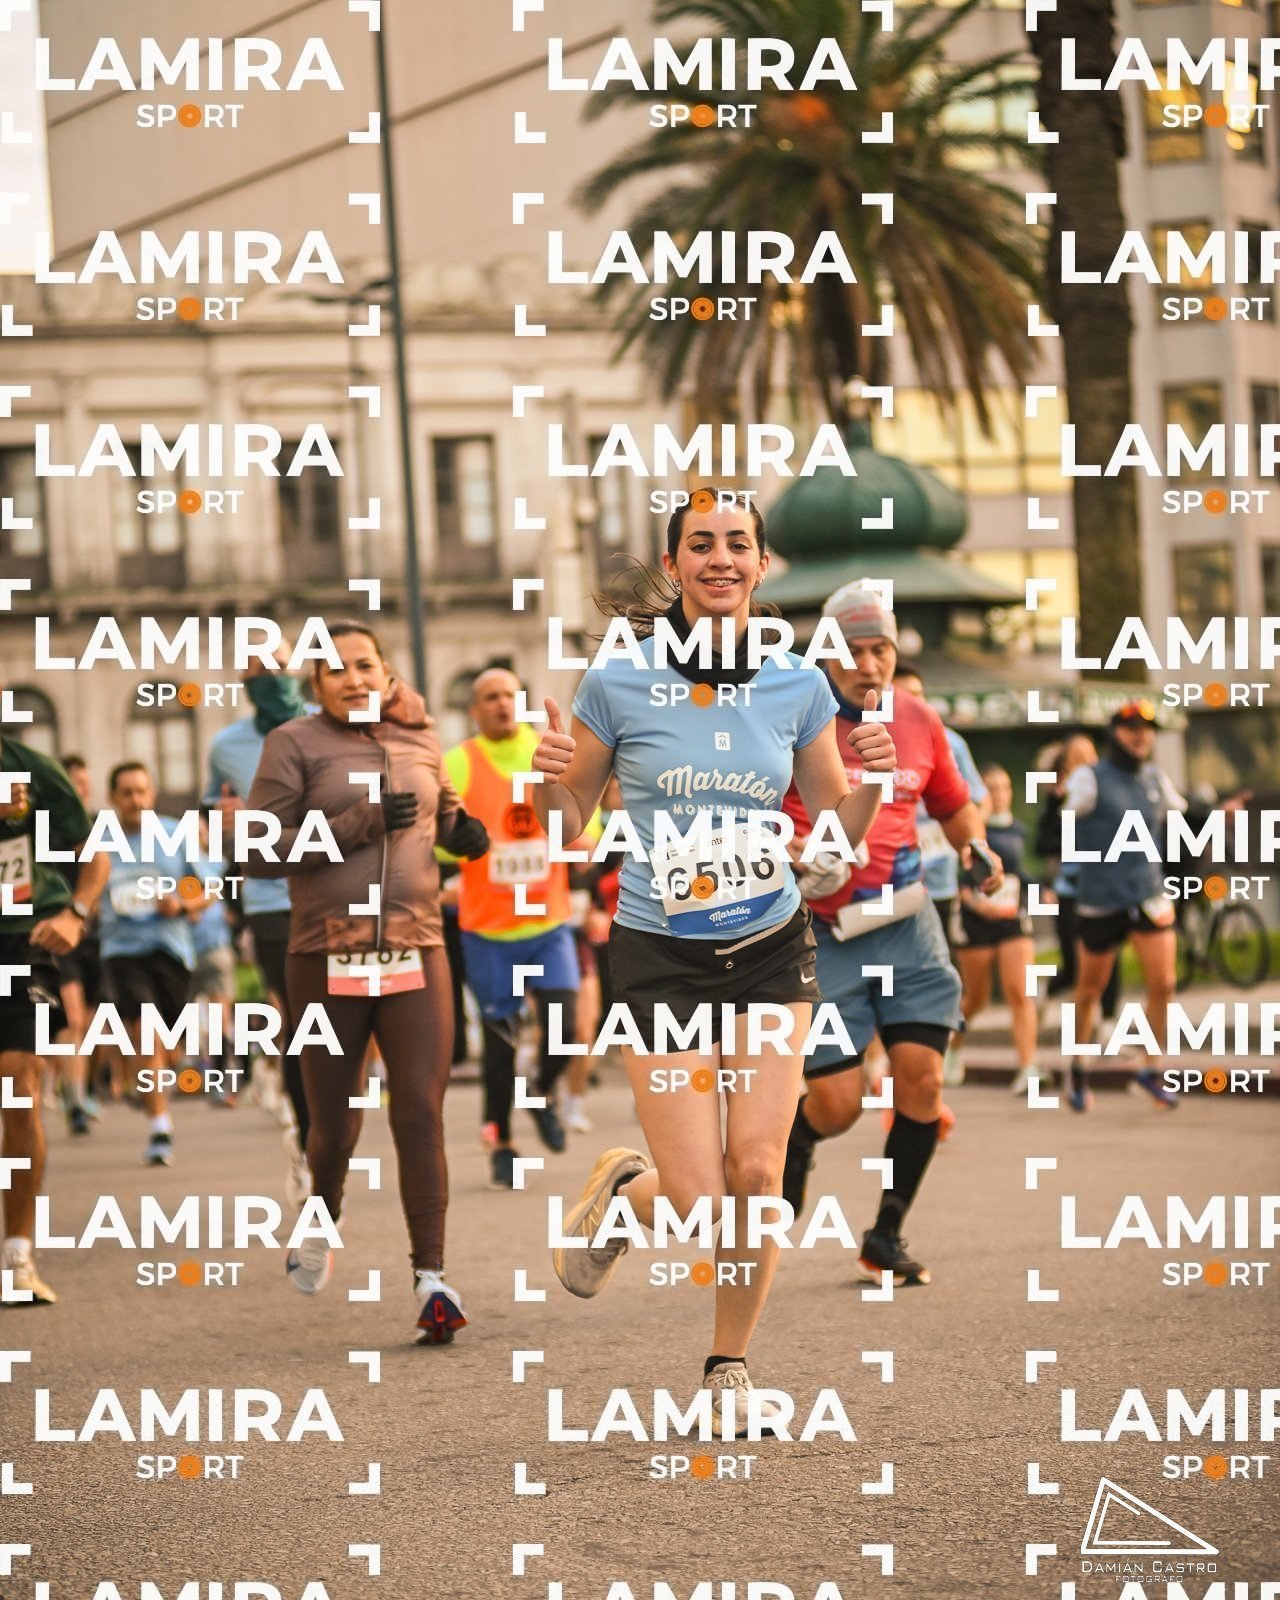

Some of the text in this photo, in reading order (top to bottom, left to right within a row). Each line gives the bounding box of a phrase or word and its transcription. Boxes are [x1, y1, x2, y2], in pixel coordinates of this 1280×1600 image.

[656, 764, 779, 806] Maratón
[672, 803, 764, 820] MONTEVID
[667, 847, 775, 901] 6506
[709, 905, 752, 923] Maratón
